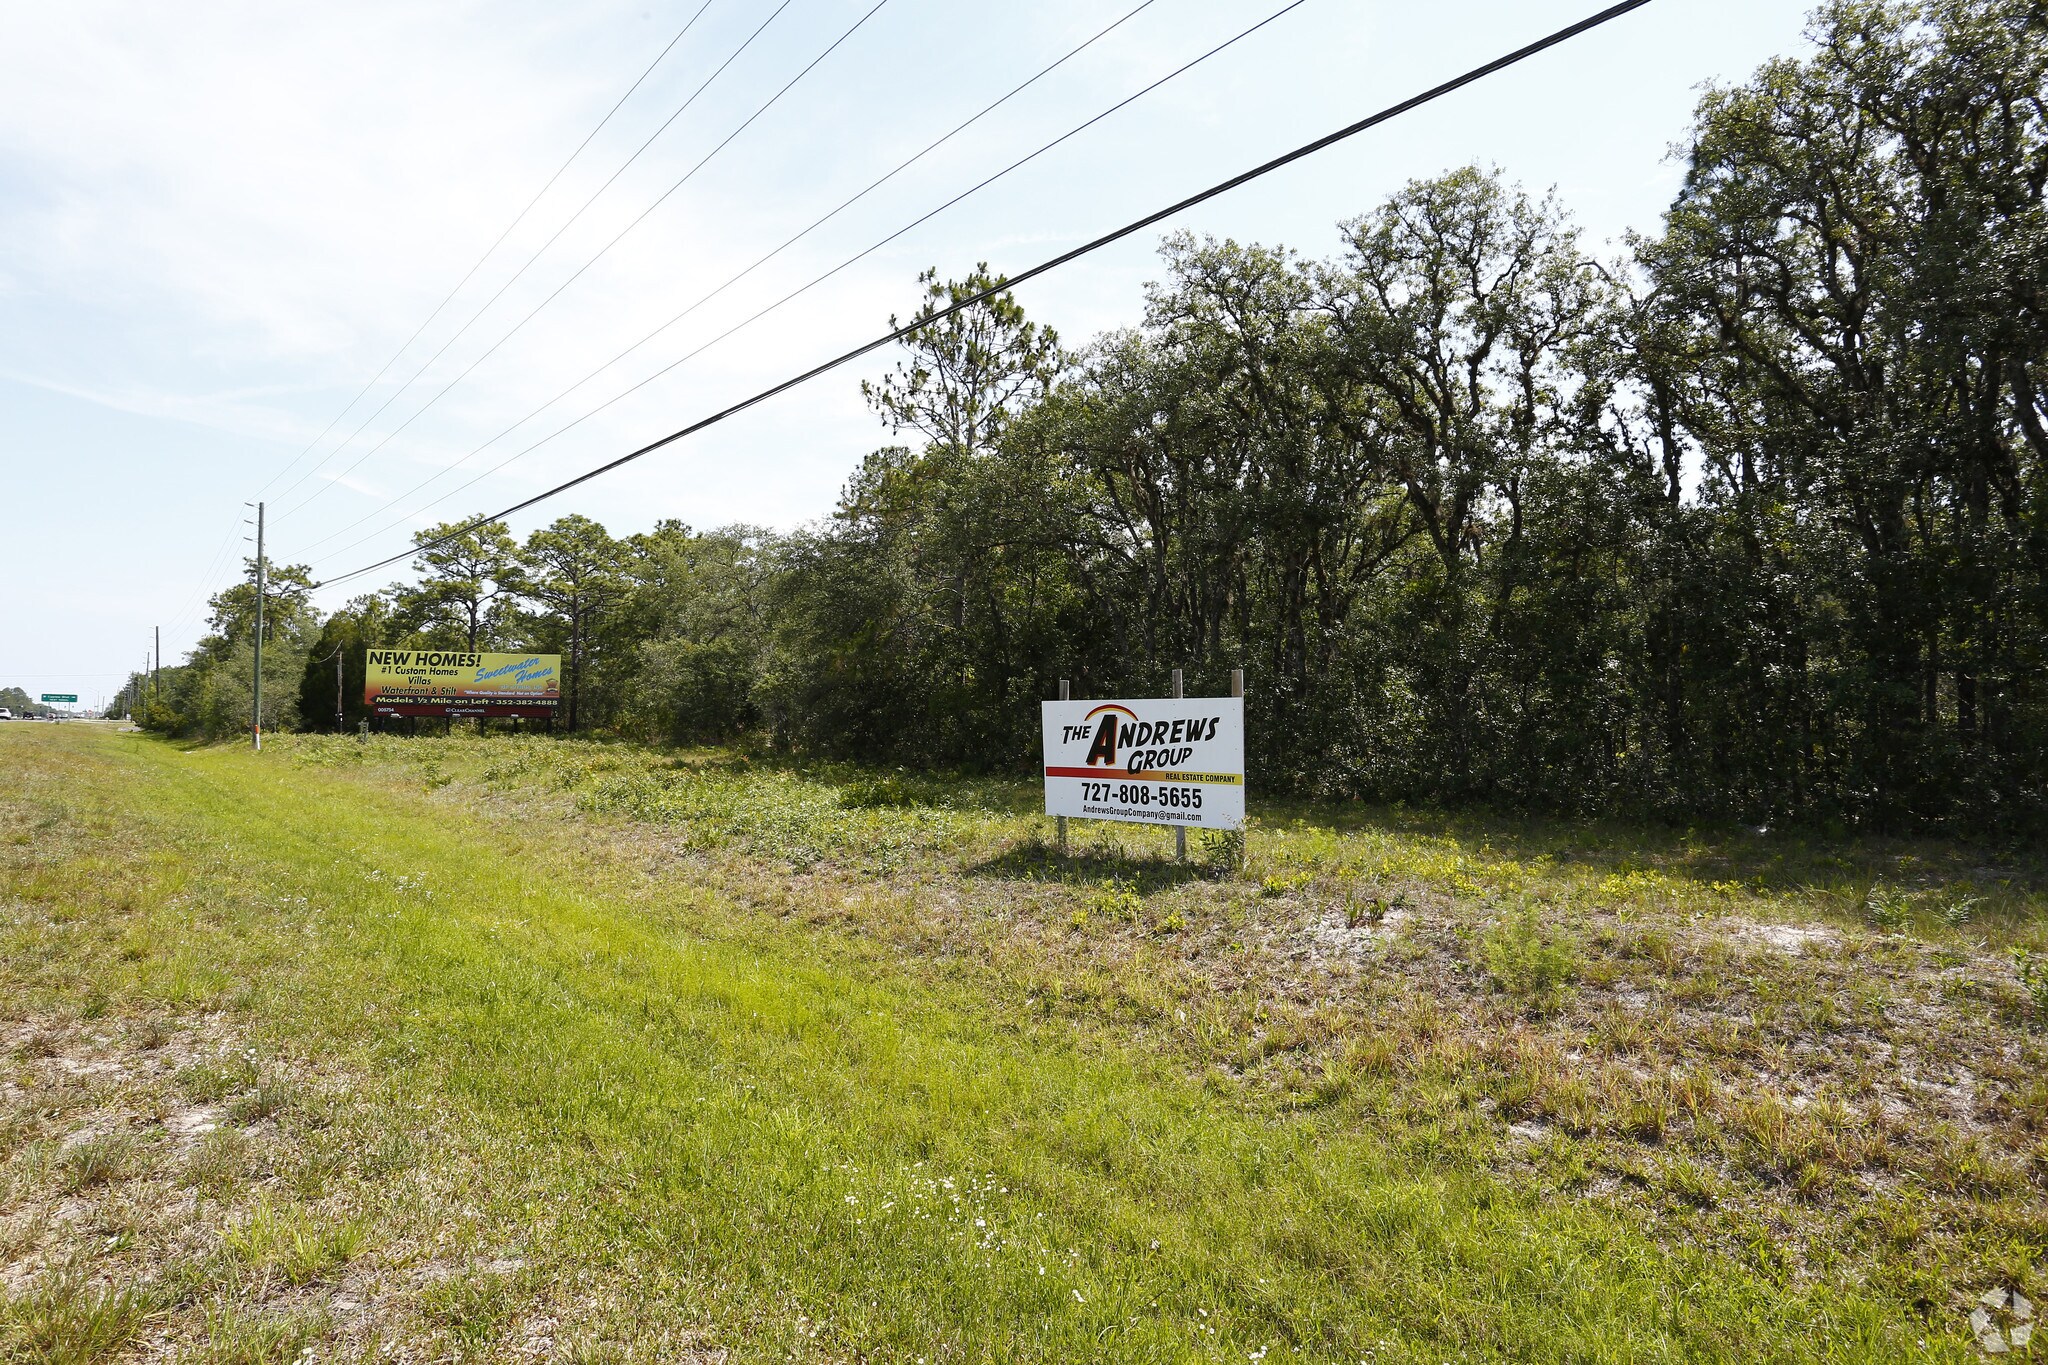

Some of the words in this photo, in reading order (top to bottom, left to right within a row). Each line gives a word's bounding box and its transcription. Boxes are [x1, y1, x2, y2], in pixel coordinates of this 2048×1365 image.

[369, 652, 411, 665] NEW
[415, 653, 482, 667] HOMES!
[381, 666, 392, 674] #1
[395, 666, 427, 675] Custom
[429, 667, 458, 675] Homes
[474, 657, 540, 682] Sweetwater
[515, 667, 553, 684] Homes
[408, 676, 431, 685] Villas
[381, 686, 429, 695] Waterfront
[431, 687, 437, 695] &
[441, 687, 457, 695] Stilt
[1062, 725, 1091, 745] THE
[1086, 714, 1221, 766] ANDREWS
[1127, 747, 1193, 775] GROUP
[1165, 773, 1181, 781] REAL
[1182, 774, 1204, 782] ESTATE
[1205, 774, 1235, 783] COMPANY
[1081, 783, 1203, 809] 727-808-5655
[1083, 805, 1202, 821] AndrewsGroupCompany@gmail.com
